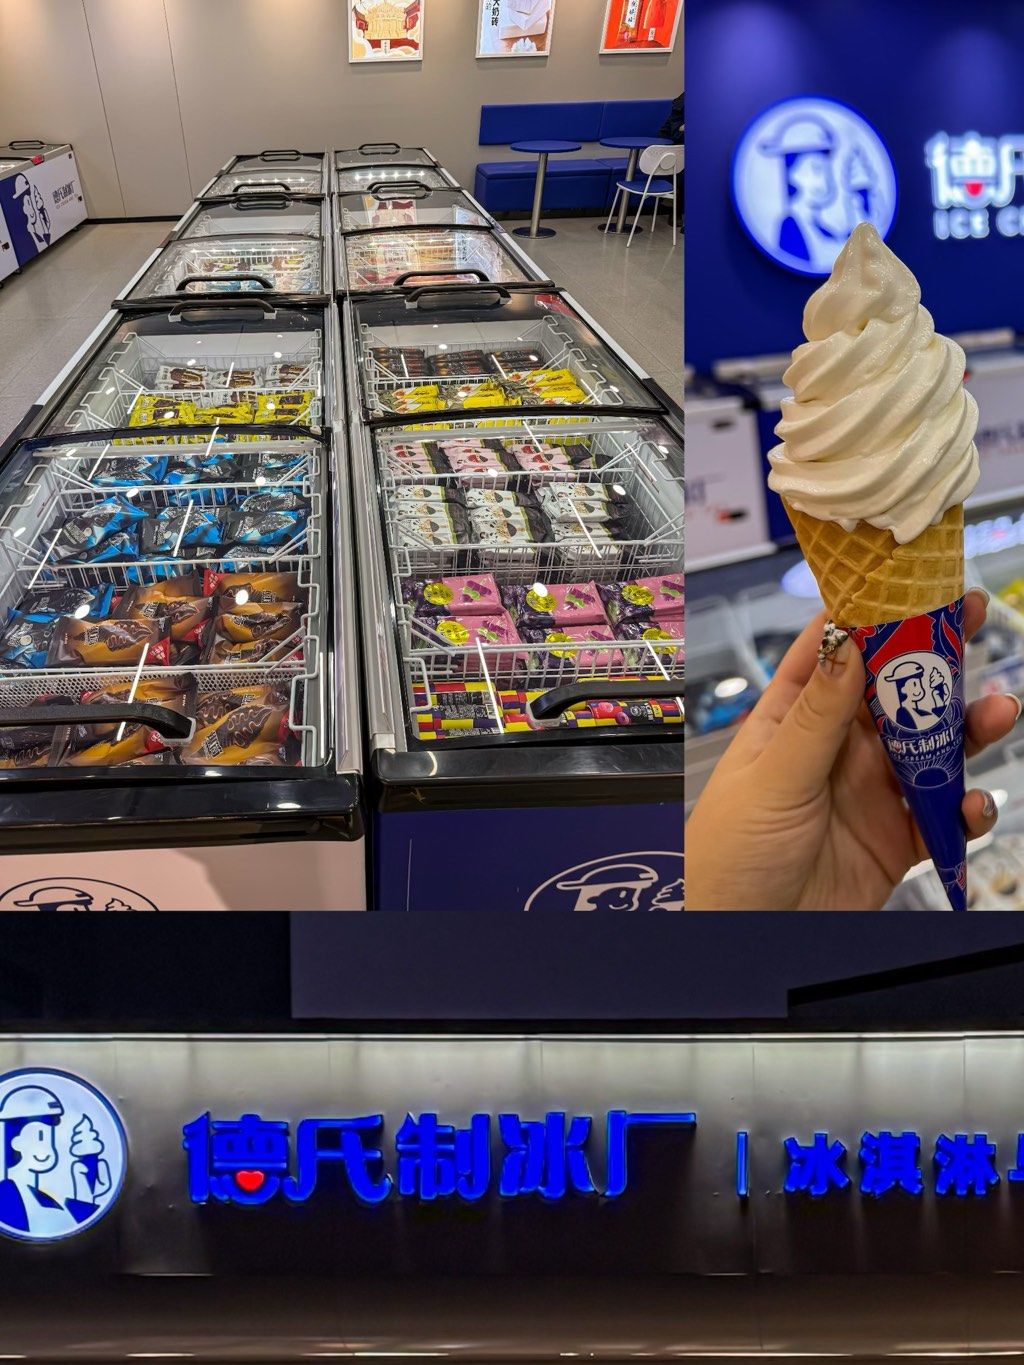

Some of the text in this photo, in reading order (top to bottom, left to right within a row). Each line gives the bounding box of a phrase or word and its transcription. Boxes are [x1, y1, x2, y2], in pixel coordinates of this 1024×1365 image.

[182, 1111, 697, 1206] 德氏制冰厂
